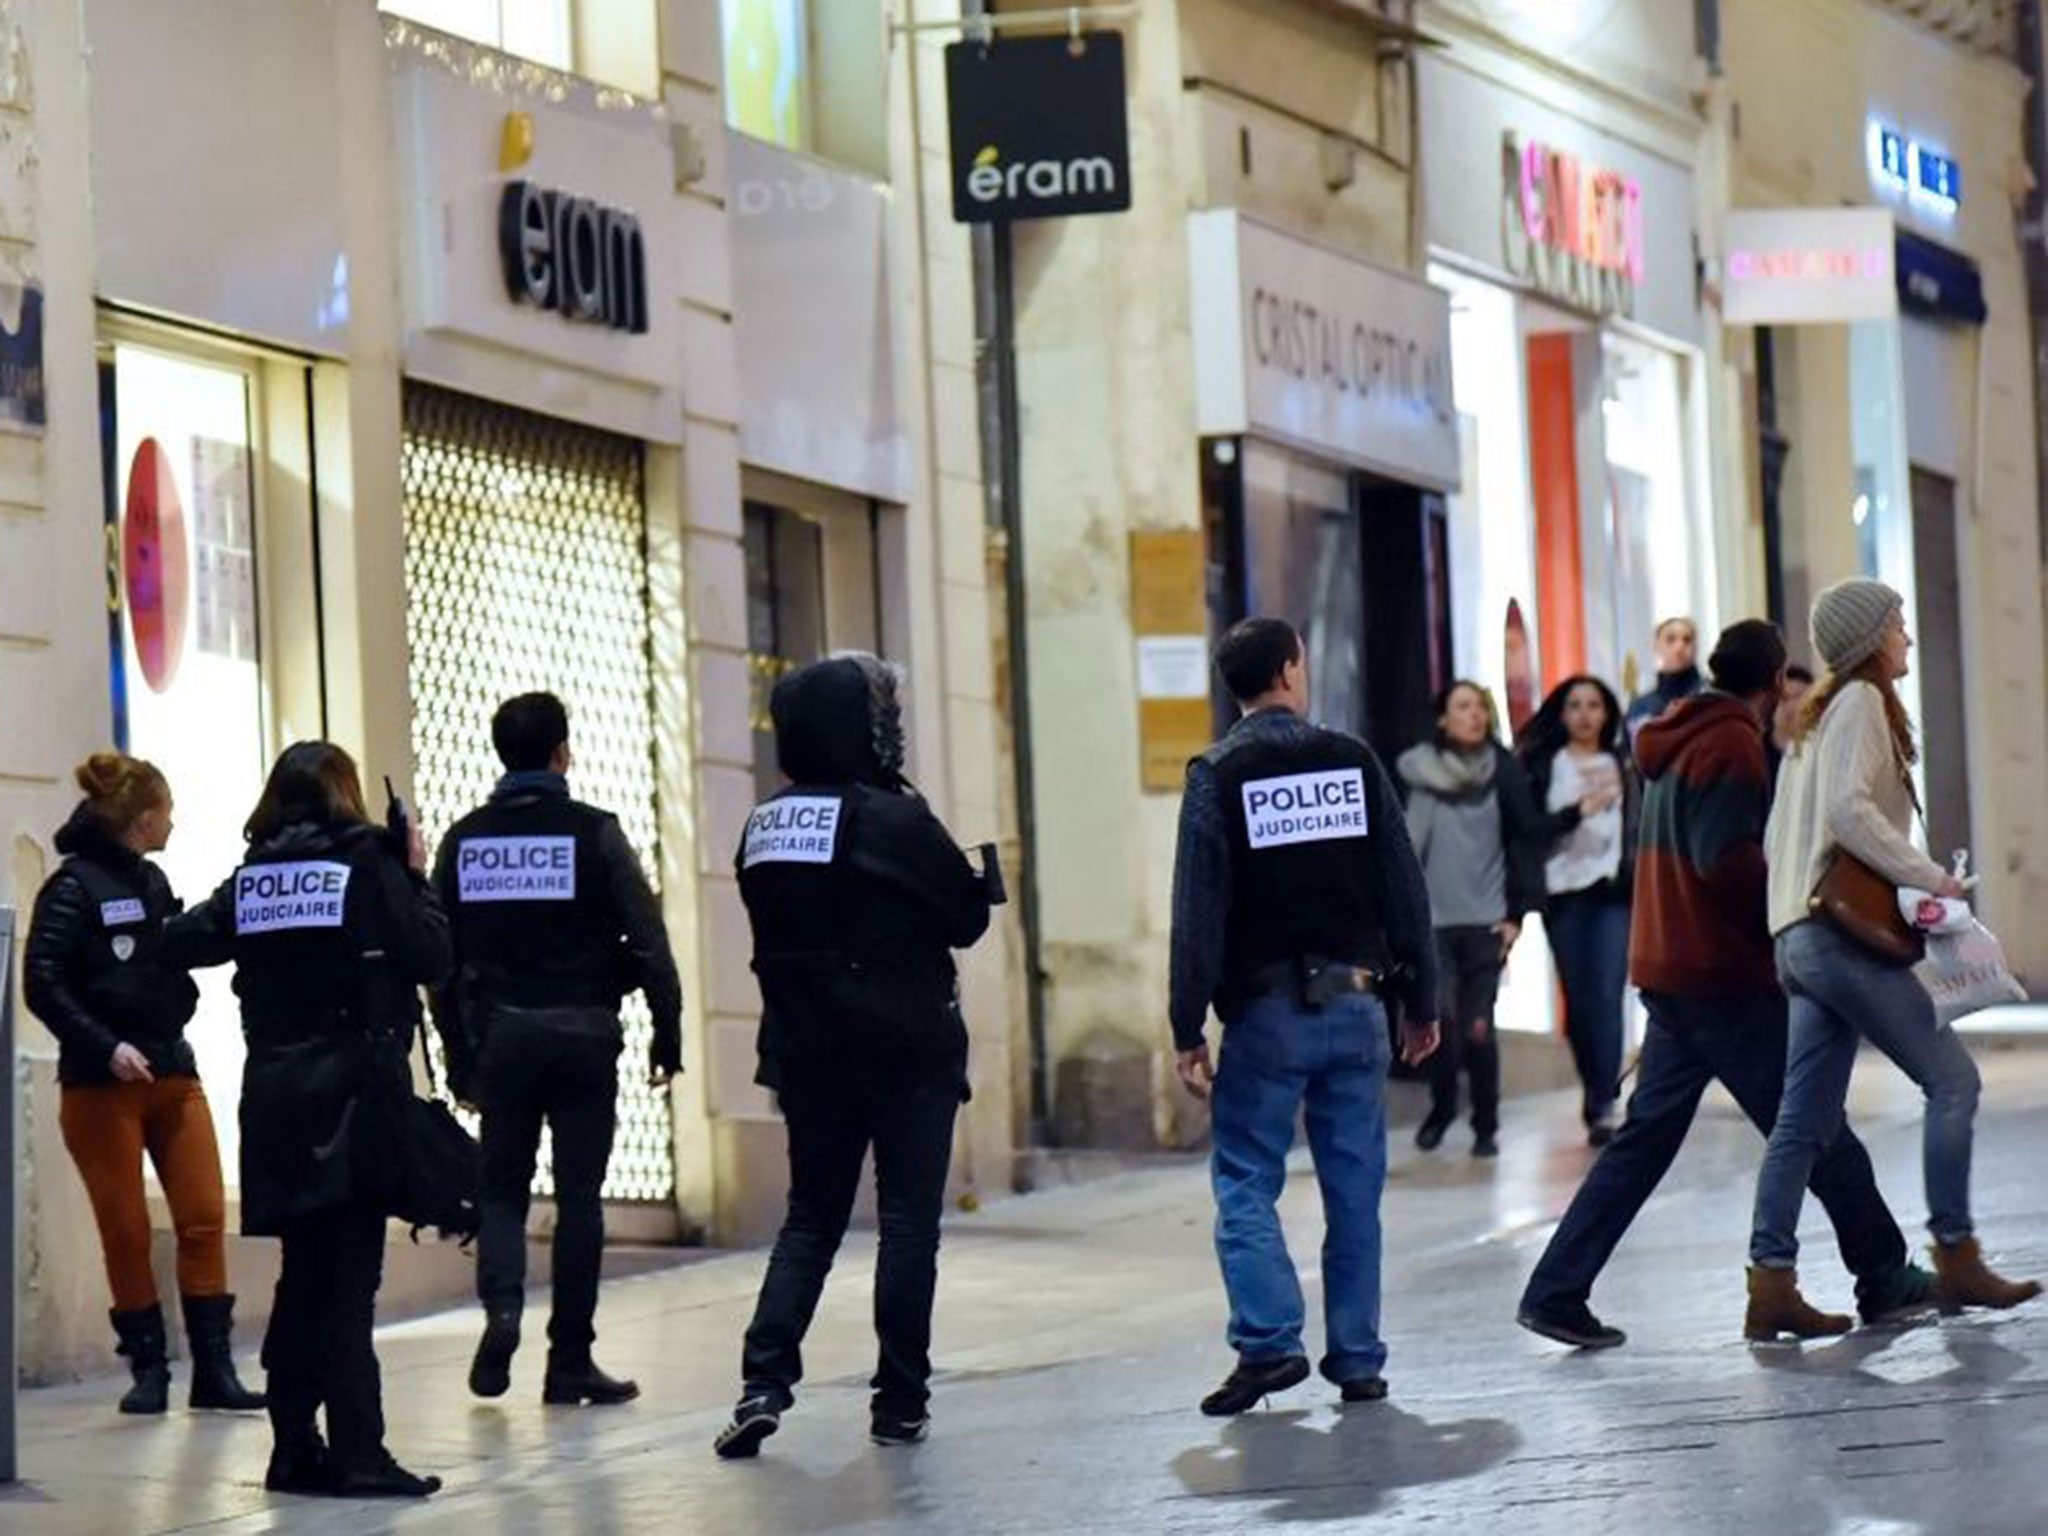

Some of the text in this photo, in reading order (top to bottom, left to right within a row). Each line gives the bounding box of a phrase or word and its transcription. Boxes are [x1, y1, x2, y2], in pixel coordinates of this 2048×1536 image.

[967, 144, 1116, 202] éram
[1253, 286, 1349, 392] CRISTAL
[1248, 780, 1361, 815] POLICE
[1254, 812, 1363, 838] JUDICIAIRE
[462, 846, 570, 871] POLICE
[239, 870, 343, 902] POLICE
[463, 876, 570, 892] JUDICIAIRE
[240, 901, 340, 924] JUDICIAIRE
